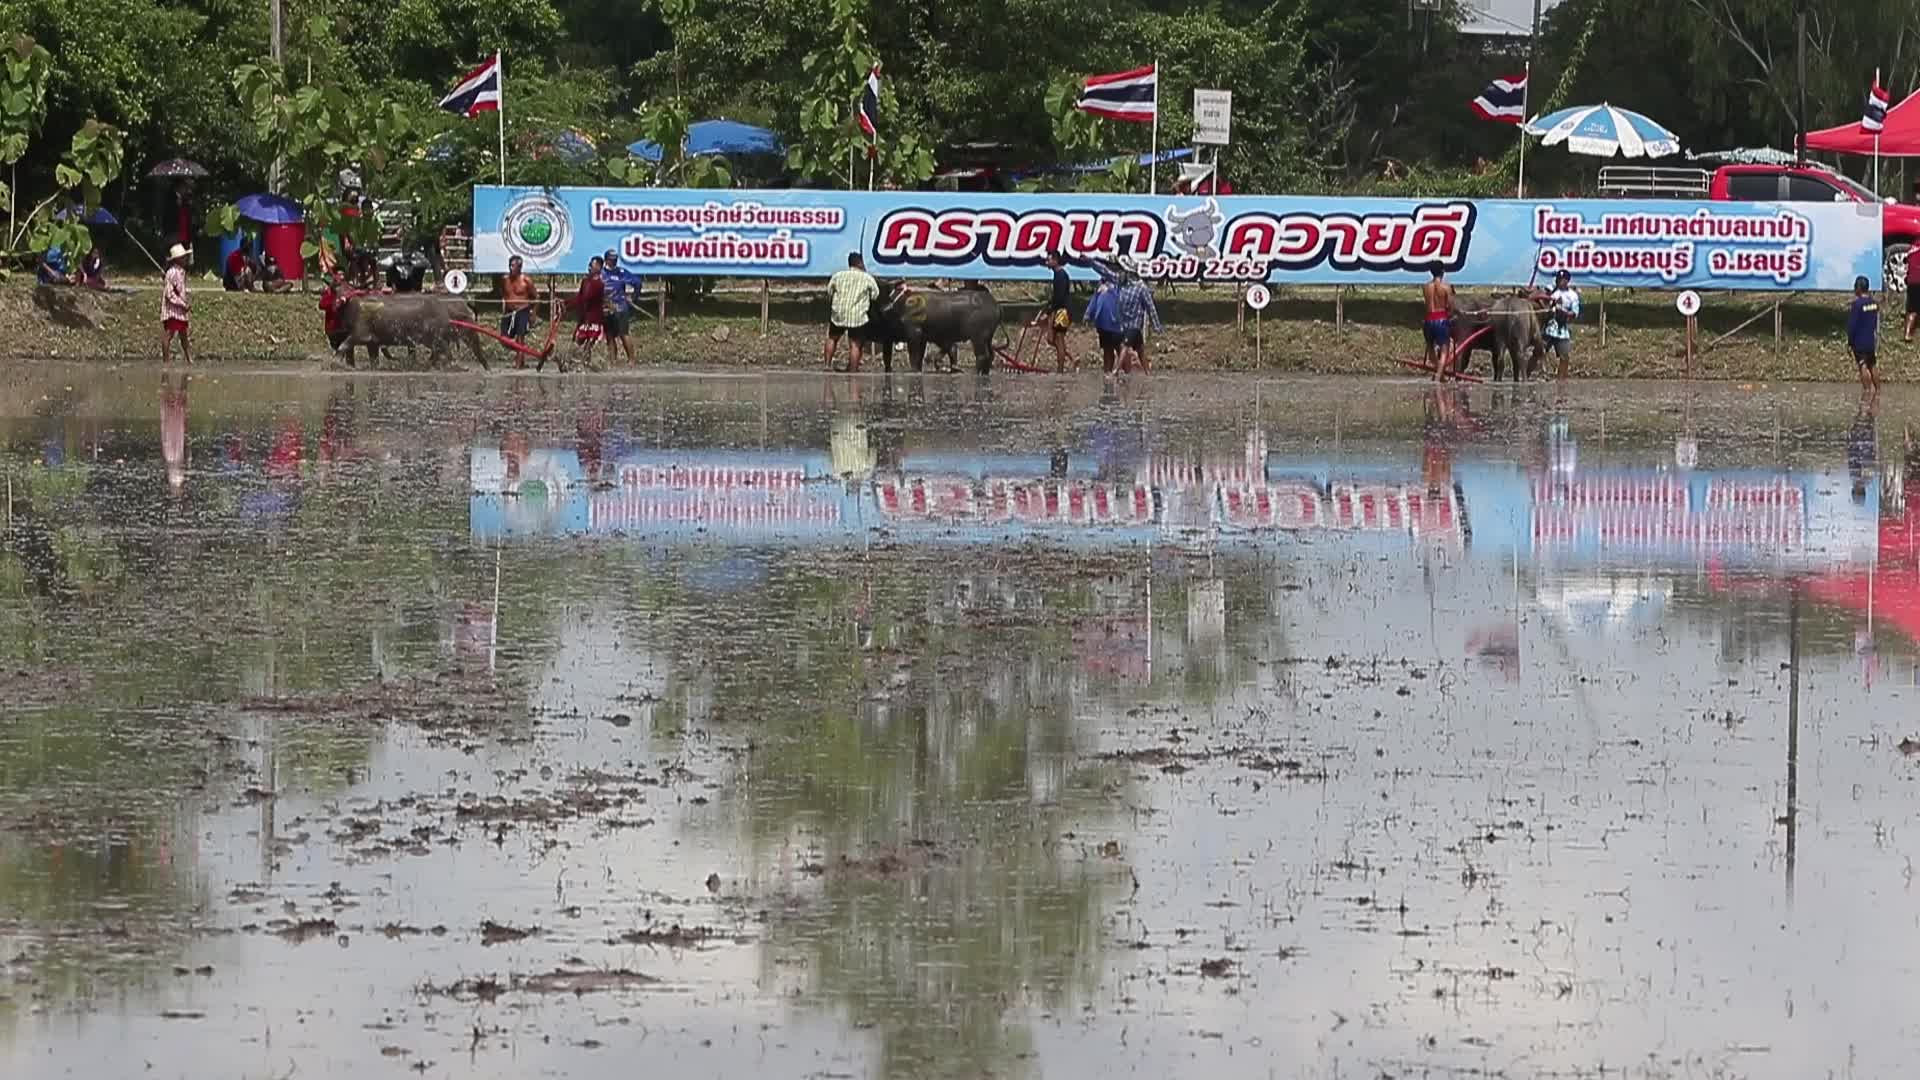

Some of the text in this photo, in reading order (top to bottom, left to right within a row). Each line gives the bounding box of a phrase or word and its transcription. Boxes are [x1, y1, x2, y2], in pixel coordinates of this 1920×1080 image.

[595, 202, 840, 228] โครงการอนุรักษ์วัฒนธรรม
[624, 232, 804, 260] ประเพณีท้องถิ่น
[881, 215, 1156, 257] คราดนา
[1227, 208, 1465, 260] ควายดี
[1138, 256, 1266, 276] ะจำปี 2565
[1540, 245, 1804, 278] อ.เมืองชลบุรี จ.ชลบุรี
